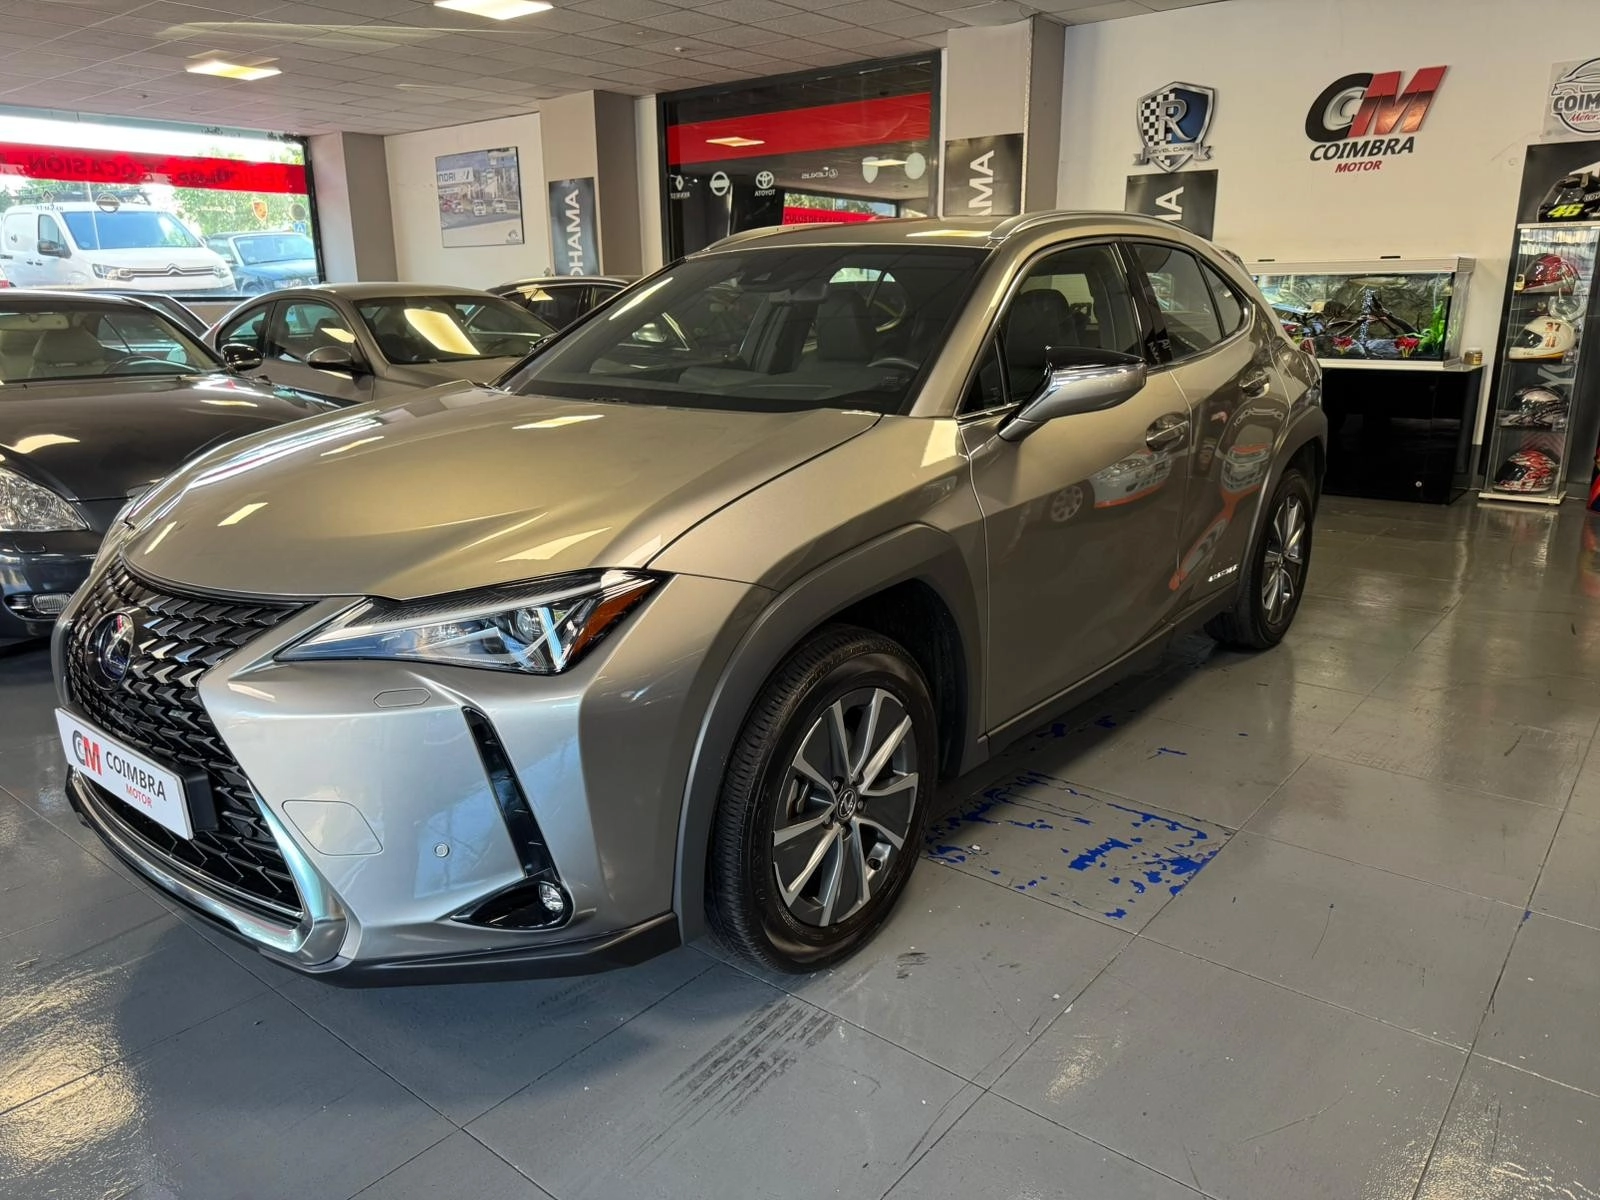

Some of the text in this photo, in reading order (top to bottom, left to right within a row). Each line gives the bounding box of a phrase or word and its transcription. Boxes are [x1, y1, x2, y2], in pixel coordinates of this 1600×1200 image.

[1309, 136, 1415, 162] COIMBRA
[1334, 160, 1382, 173] MOTOR
[1547, 203, 1584, 218] 46
[106, 751, 167, 801] COIMBRA
[125, 783, 152, 808] MOTOR
